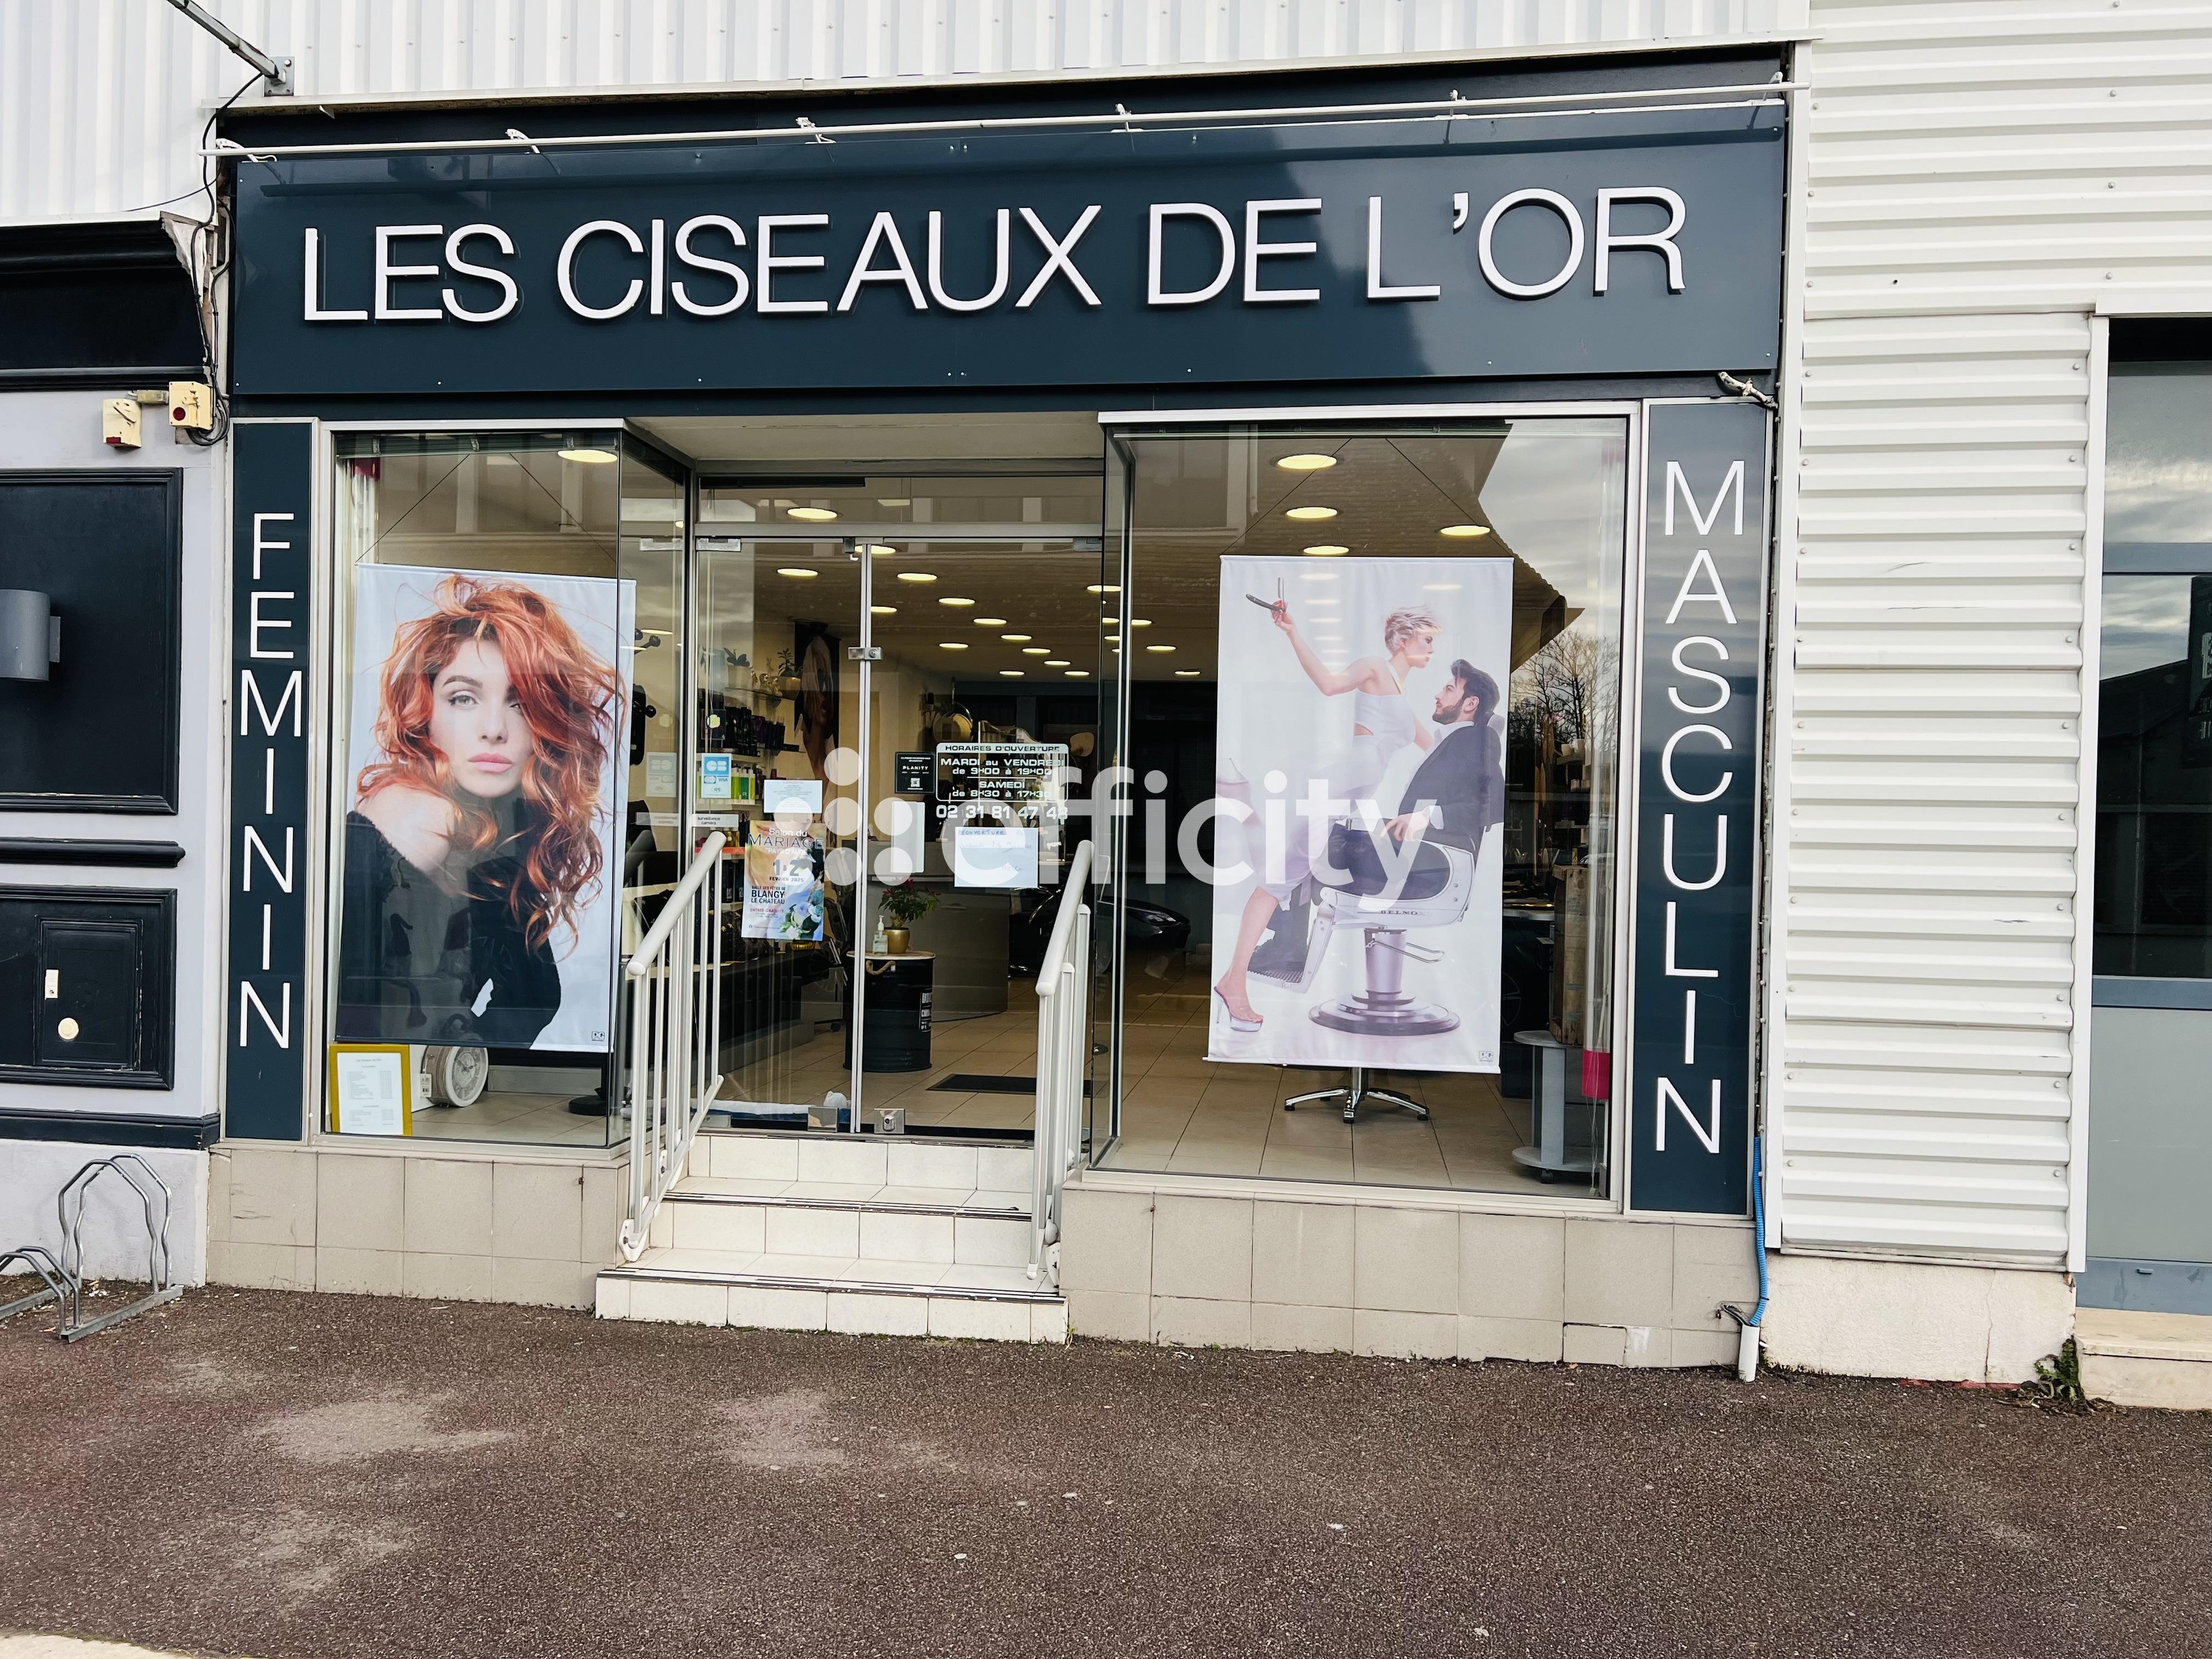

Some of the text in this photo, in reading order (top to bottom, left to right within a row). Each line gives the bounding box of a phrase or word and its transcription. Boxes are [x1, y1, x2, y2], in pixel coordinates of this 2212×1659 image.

[304, 186, 1687, 322] LES CISEAUX DE L'OR
[940, 758, 980, 766] MARDI
[1004, 758, 1064, 767] VENDREDI
[1005, 767, 1011, 775] à
[240, 513, 303, 1049] FEMININ
[1005, 789, 1011, 798] à
[936, 804, 958, 819] 02
[966, 805, 984, 819] 31
[991, 805, 1010, 819] 81
[1017, 806, 1039, 819] 47
[1656, 460, 1745, 1154] MASCULIN
[769, 828, 807, 837] Salon du
[748, 833, 824, 849] MARIAGE
[789, 859, 799, 877] 2
[751, 890, 785, 899] BLANGY
